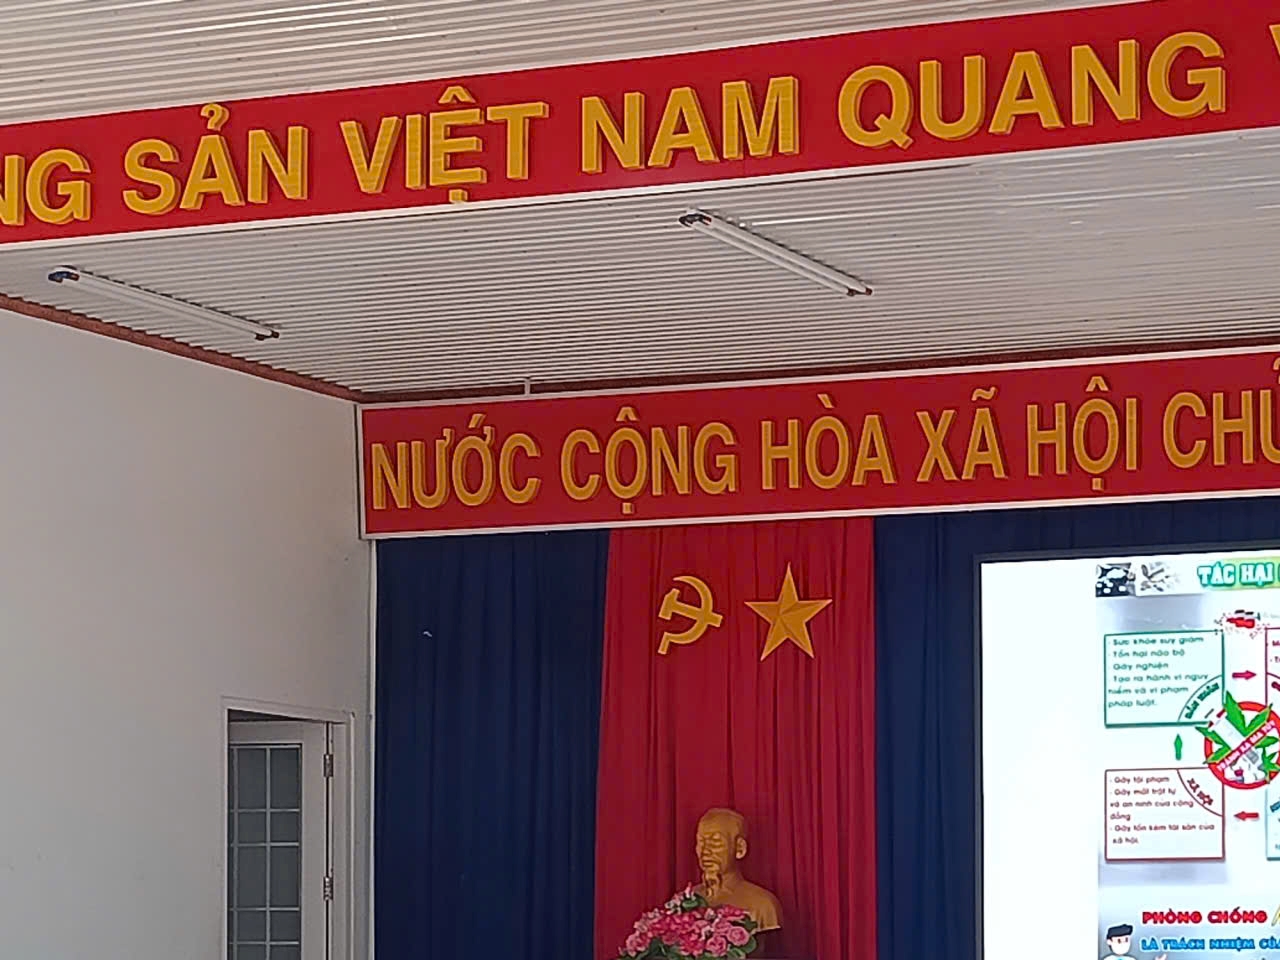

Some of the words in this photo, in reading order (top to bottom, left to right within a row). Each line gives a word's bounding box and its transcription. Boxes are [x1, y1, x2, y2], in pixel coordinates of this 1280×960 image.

[123, 103, 309, 215] SẢN
[340, 86, 549, 204] VIỆT
[581, 75, 800, 175] NAM
[838, 31, 1227, 150] QUANG
[371, 413, 541, 510] NƯỚC
[560, 406, 739, 514] CỘNG
[760, 393, 897, 491] HÒA
[917, 386, 1006, 482] XÃ
[1027, 375, 1139, 491] HỘI
[1197, 561, 1236, 587] TÁC
[1239, 562, 1275, 588] HẠI
[1142, 908, 1202, 924] PHÒNG
[1141, 937, 1159, 950] LÀ
